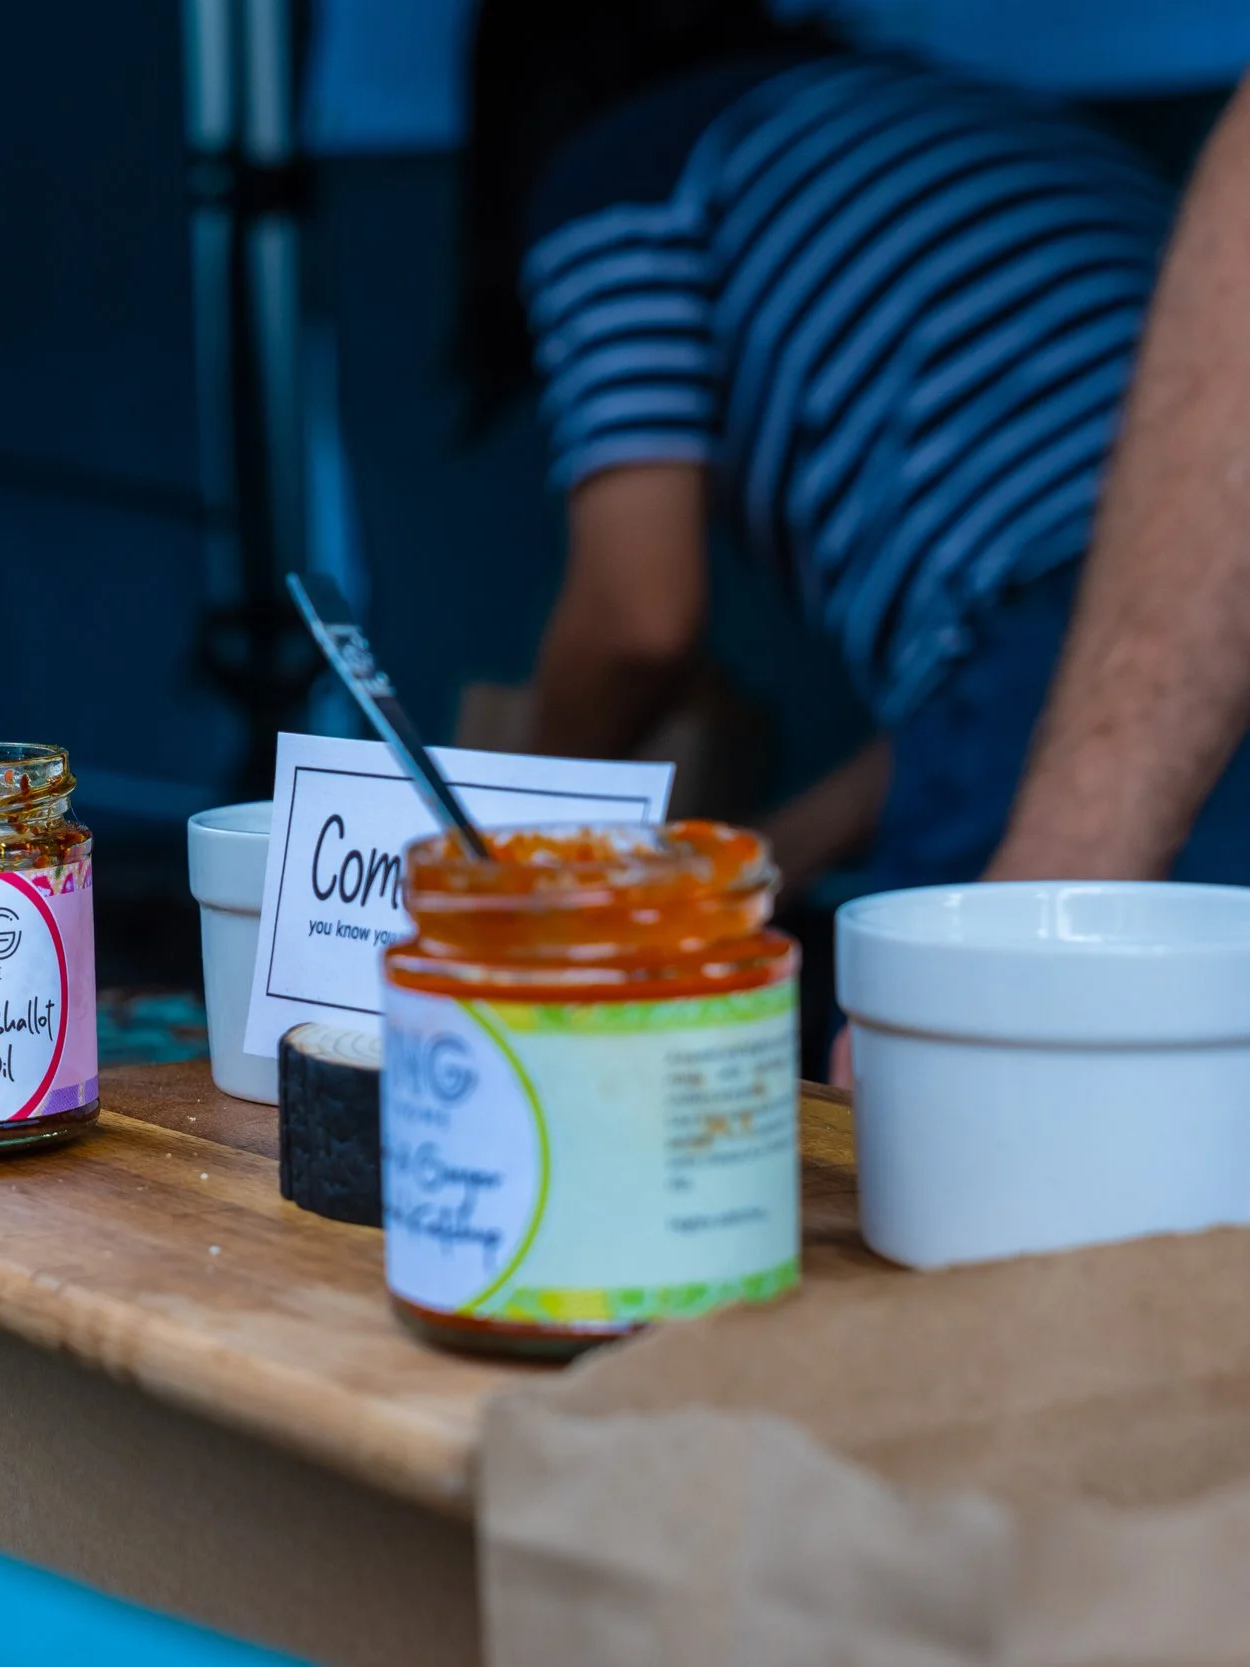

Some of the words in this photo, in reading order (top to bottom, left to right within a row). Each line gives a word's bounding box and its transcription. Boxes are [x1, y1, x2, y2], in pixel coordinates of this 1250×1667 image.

[311, 814, 402, 910] Com
[308, 919, 332, 937] you
[335, 920, 371, 941] know
[387, 1028, 479, 1109] NG
